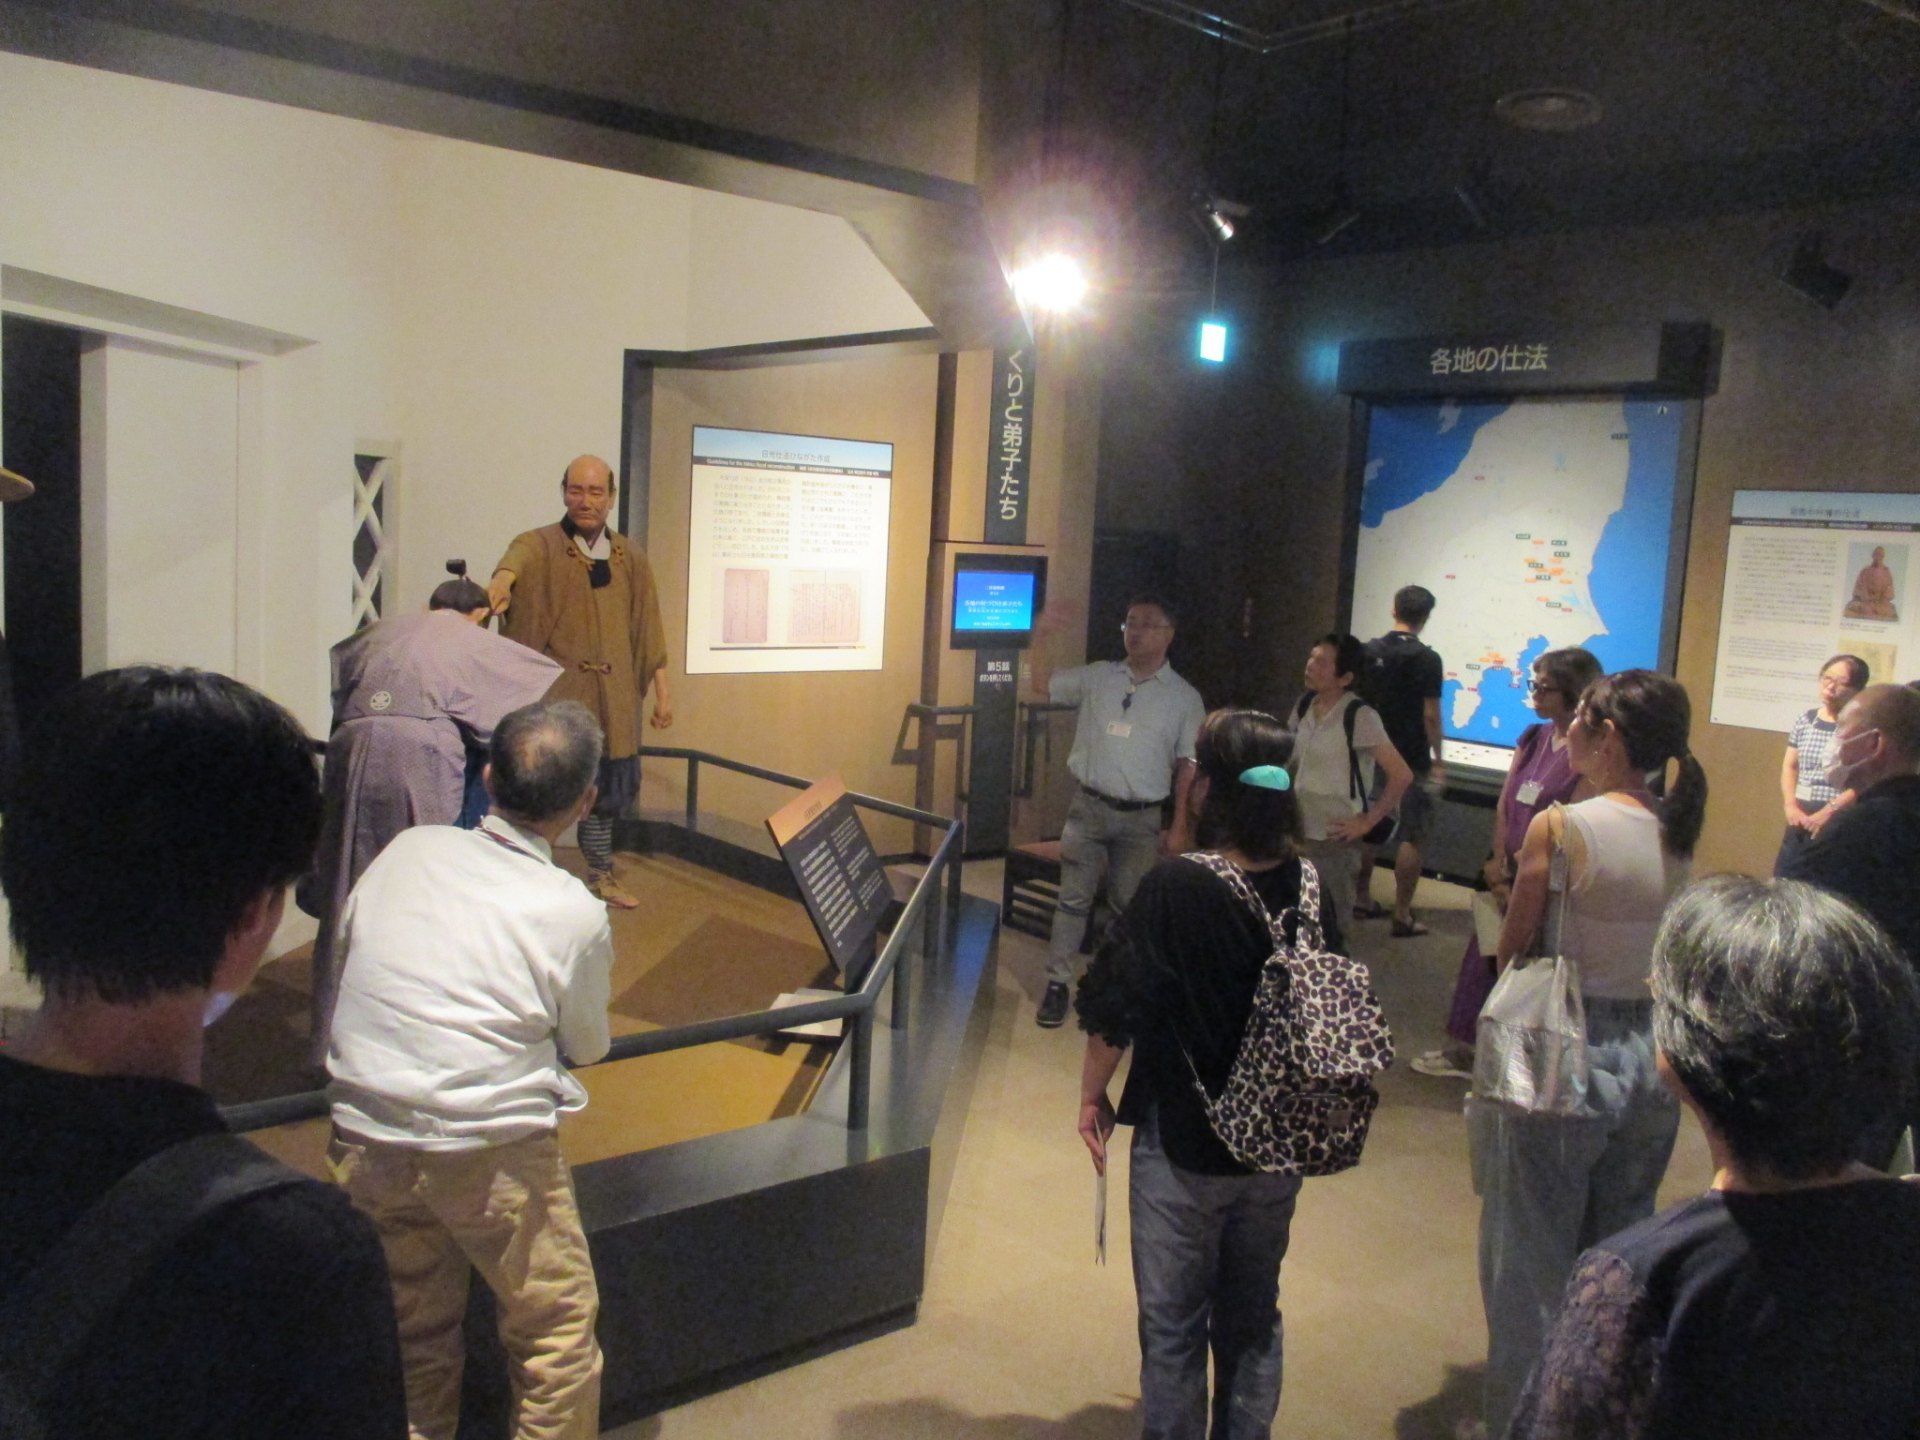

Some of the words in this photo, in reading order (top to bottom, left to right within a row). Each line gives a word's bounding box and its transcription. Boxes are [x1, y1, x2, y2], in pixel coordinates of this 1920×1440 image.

[1430, 344, 1549, 375] 各地の仕法
[1000, 349, 1024, 520] くりと弟子たち
[987, 661, 1010, 671] 第5話
